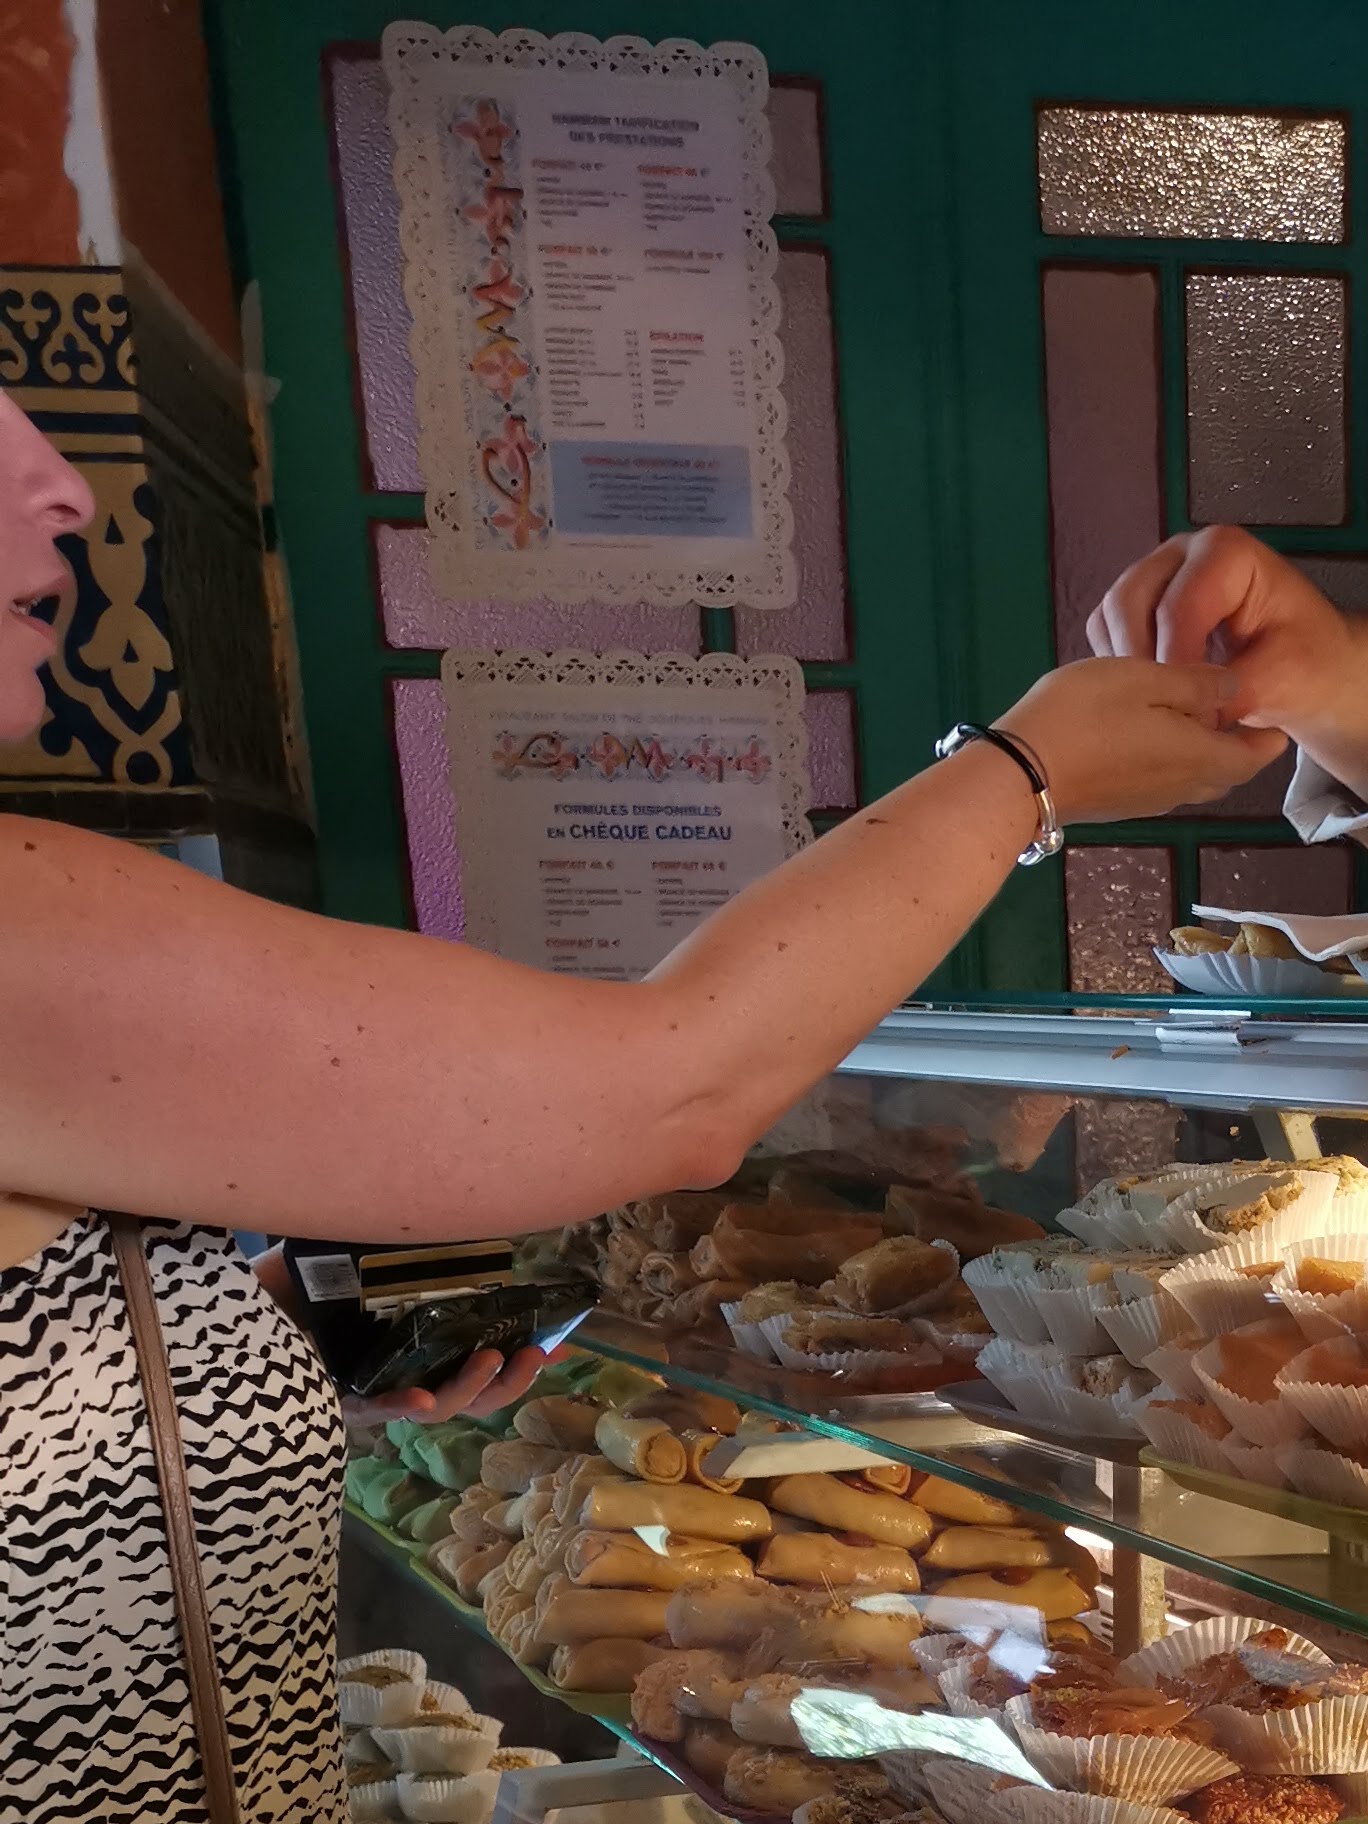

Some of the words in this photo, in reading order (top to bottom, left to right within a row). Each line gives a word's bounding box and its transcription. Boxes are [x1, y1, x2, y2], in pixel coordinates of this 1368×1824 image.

[555, 804, 629, 816] FORMULES
[633, 804, 722, 817] DISPONIBLES
[547, 827, 565, 838] EN
[656, 824, 731, 841] CADEAU
